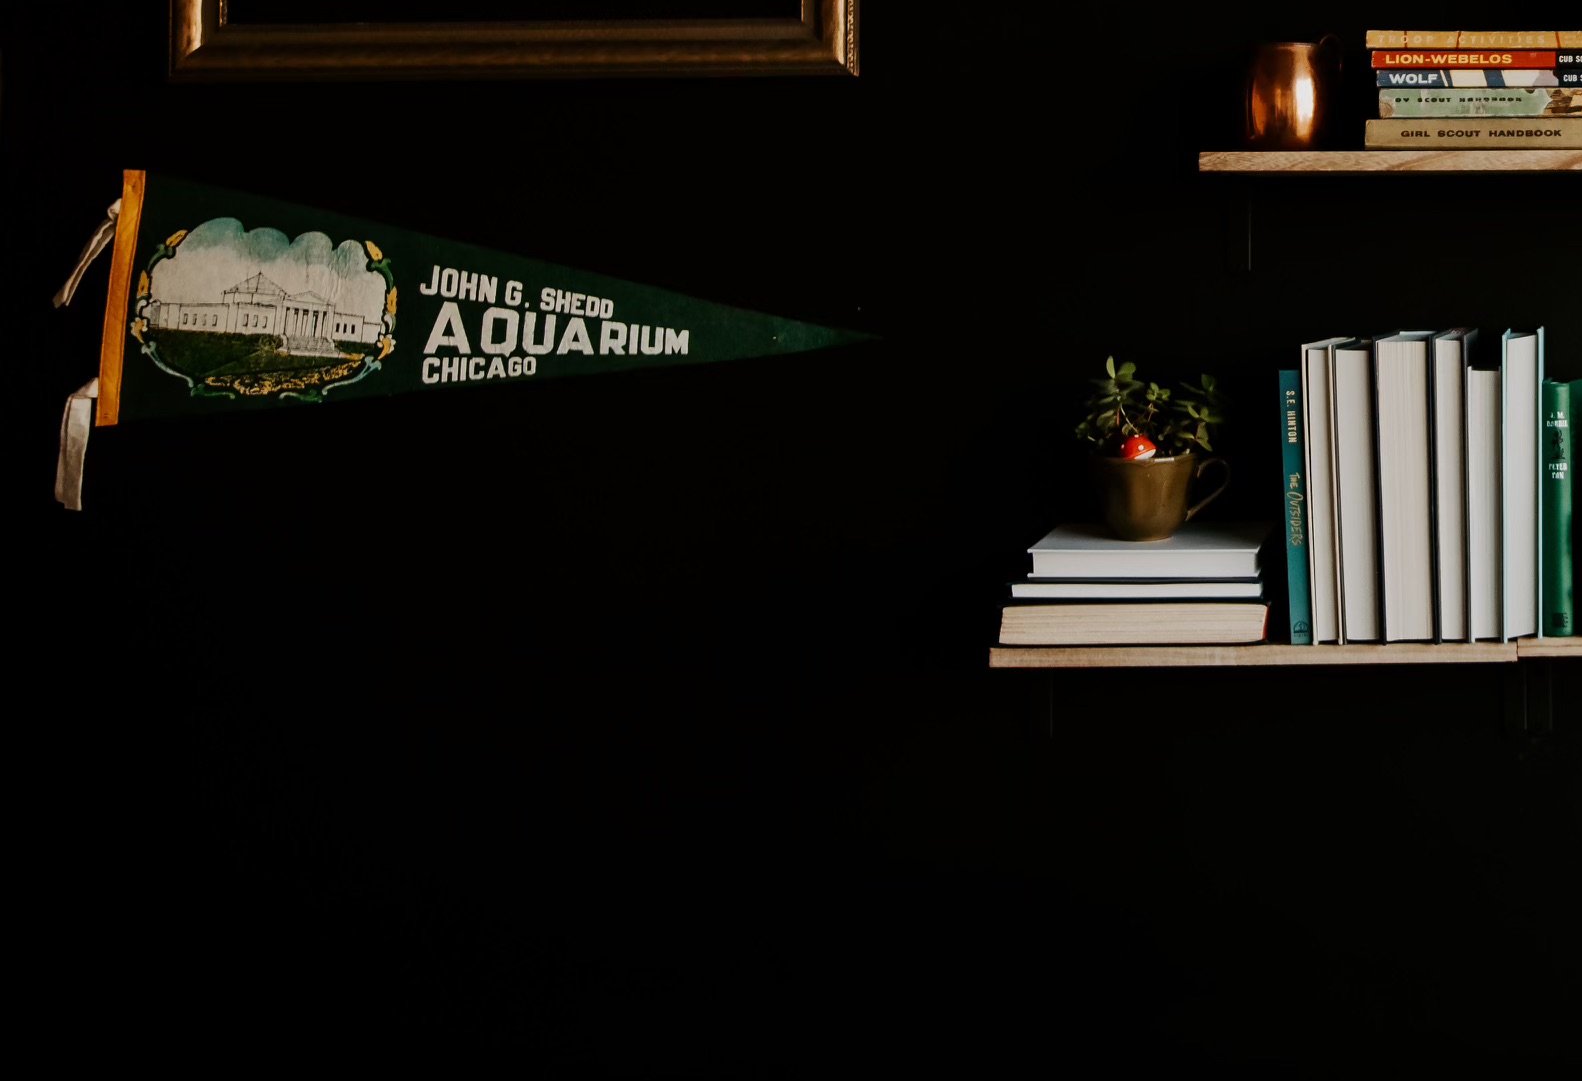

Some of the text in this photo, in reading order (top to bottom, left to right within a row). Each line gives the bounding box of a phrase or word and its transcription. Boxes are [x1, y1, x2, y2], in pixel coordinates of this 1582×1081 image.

[1377, 33, 1545, 44] TROOP ACTIVITIES
[1385, 54, 1513, 64] LION-WEBELOS
[1559, 55, 1574, 63] CUB
[1389, 73, 1438, 84] WOLF
[1563, 74, 1578, 82] CUB
[1401, 129, 1563, 138] GIRL SCOUT HANDBOOK
[420, 265, 615, 319] JOHN G. SHEDD
[423, 301, 690, 358] AQUARIUM
[422, 356, 537, 384] CHICAGO
[1287, 411, 1297, 443] HINTON
[1548, 462, 1568, 471] PETER
[1287, 492, 1304, 547] OUTSIDERS
